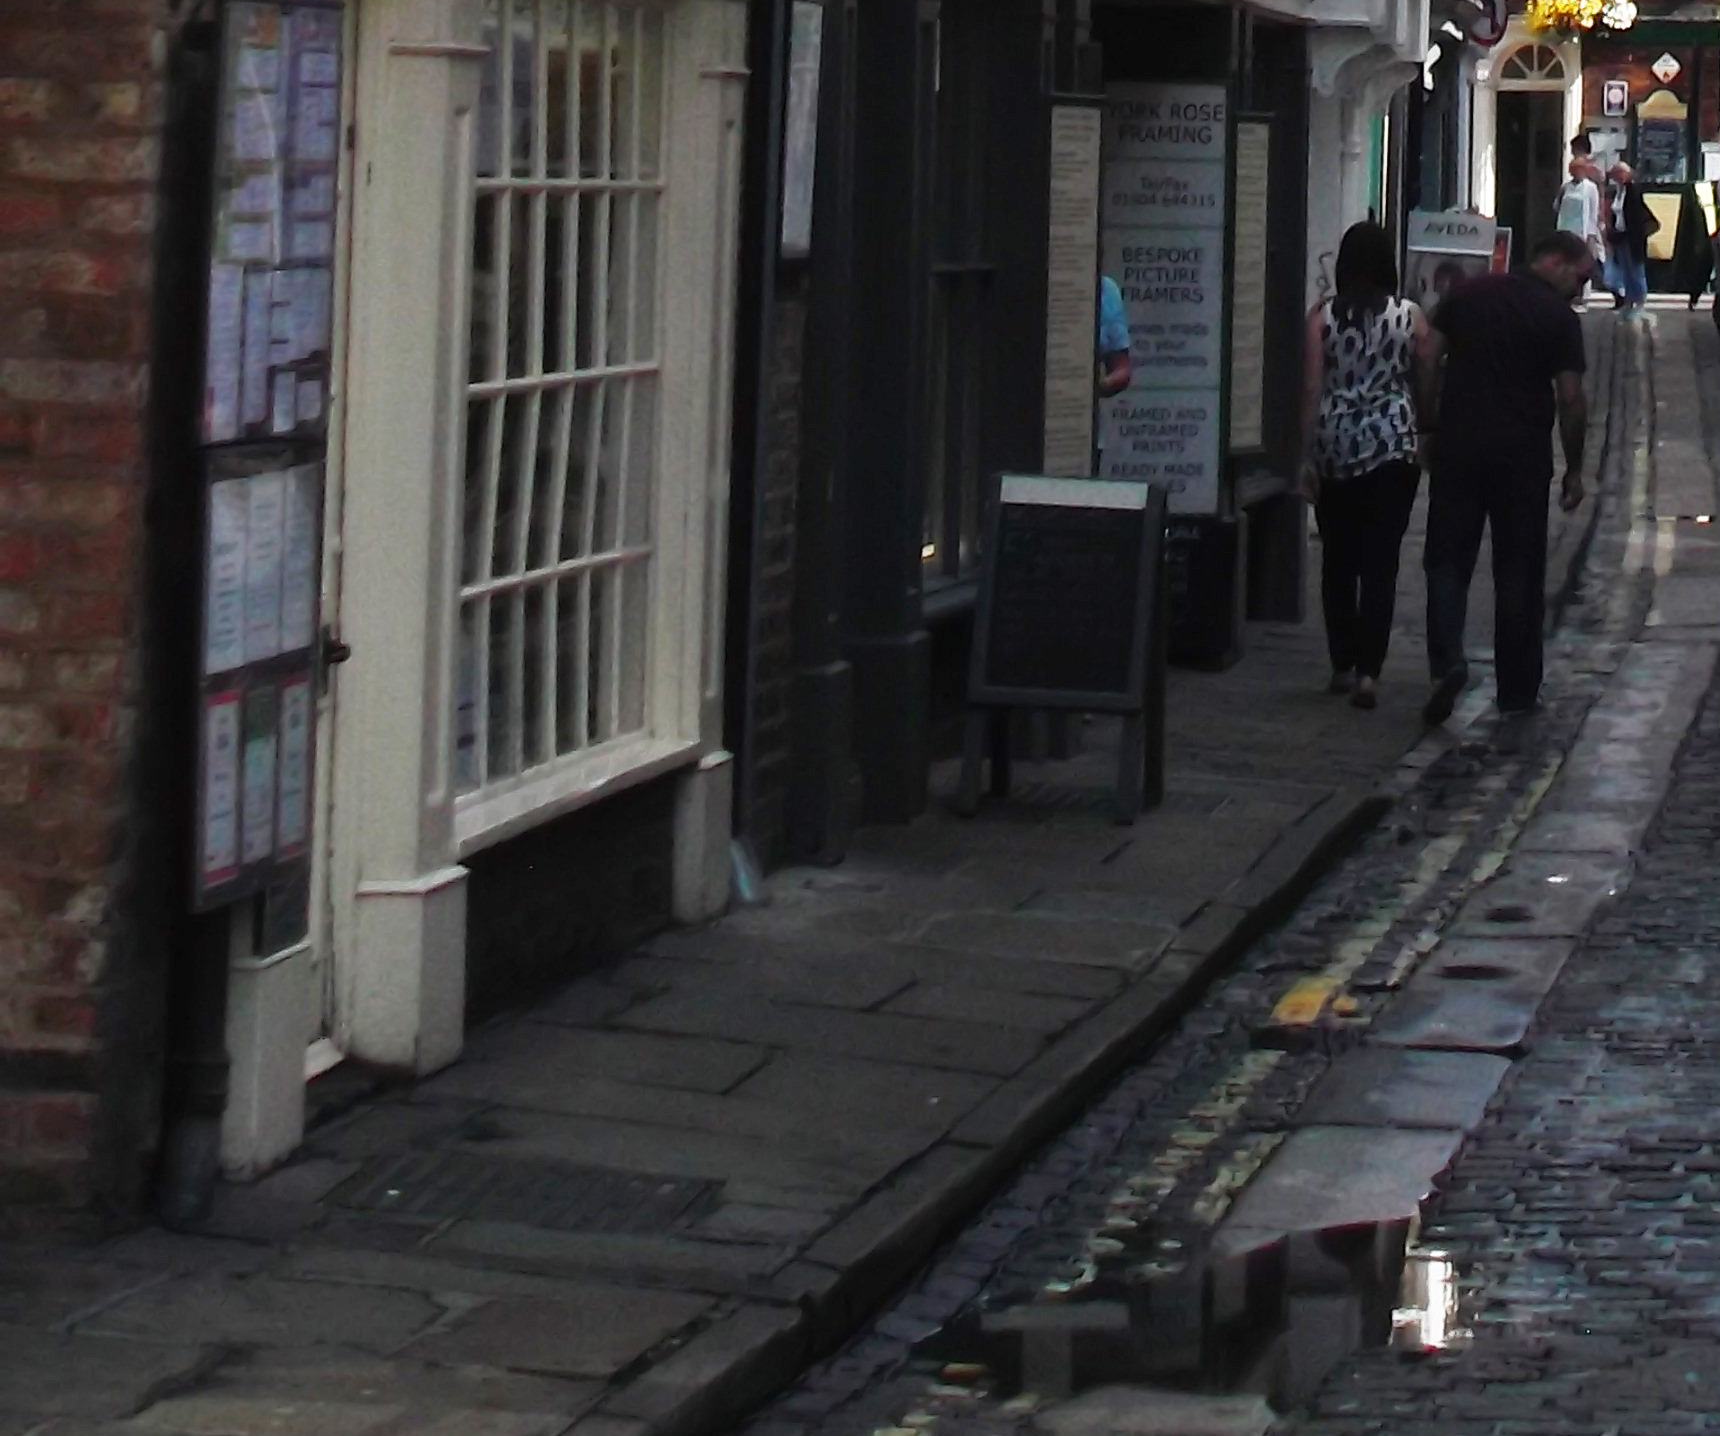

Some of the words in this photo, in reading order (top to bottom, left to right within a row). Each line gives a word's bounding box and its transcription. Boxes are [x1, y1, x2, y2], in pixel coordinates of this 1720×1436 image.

[1171, 103, 1225, 122] ROSE
[1119, 124, 1213, 145] FRAMING
[1424, 222, 1480, 236] AVEDA
[1121, 247, 1204, 264] BESPOKE
[1124, 267, 1200, 284] PICTURE
[1121, 287, 1204, 304] FRAMERS
